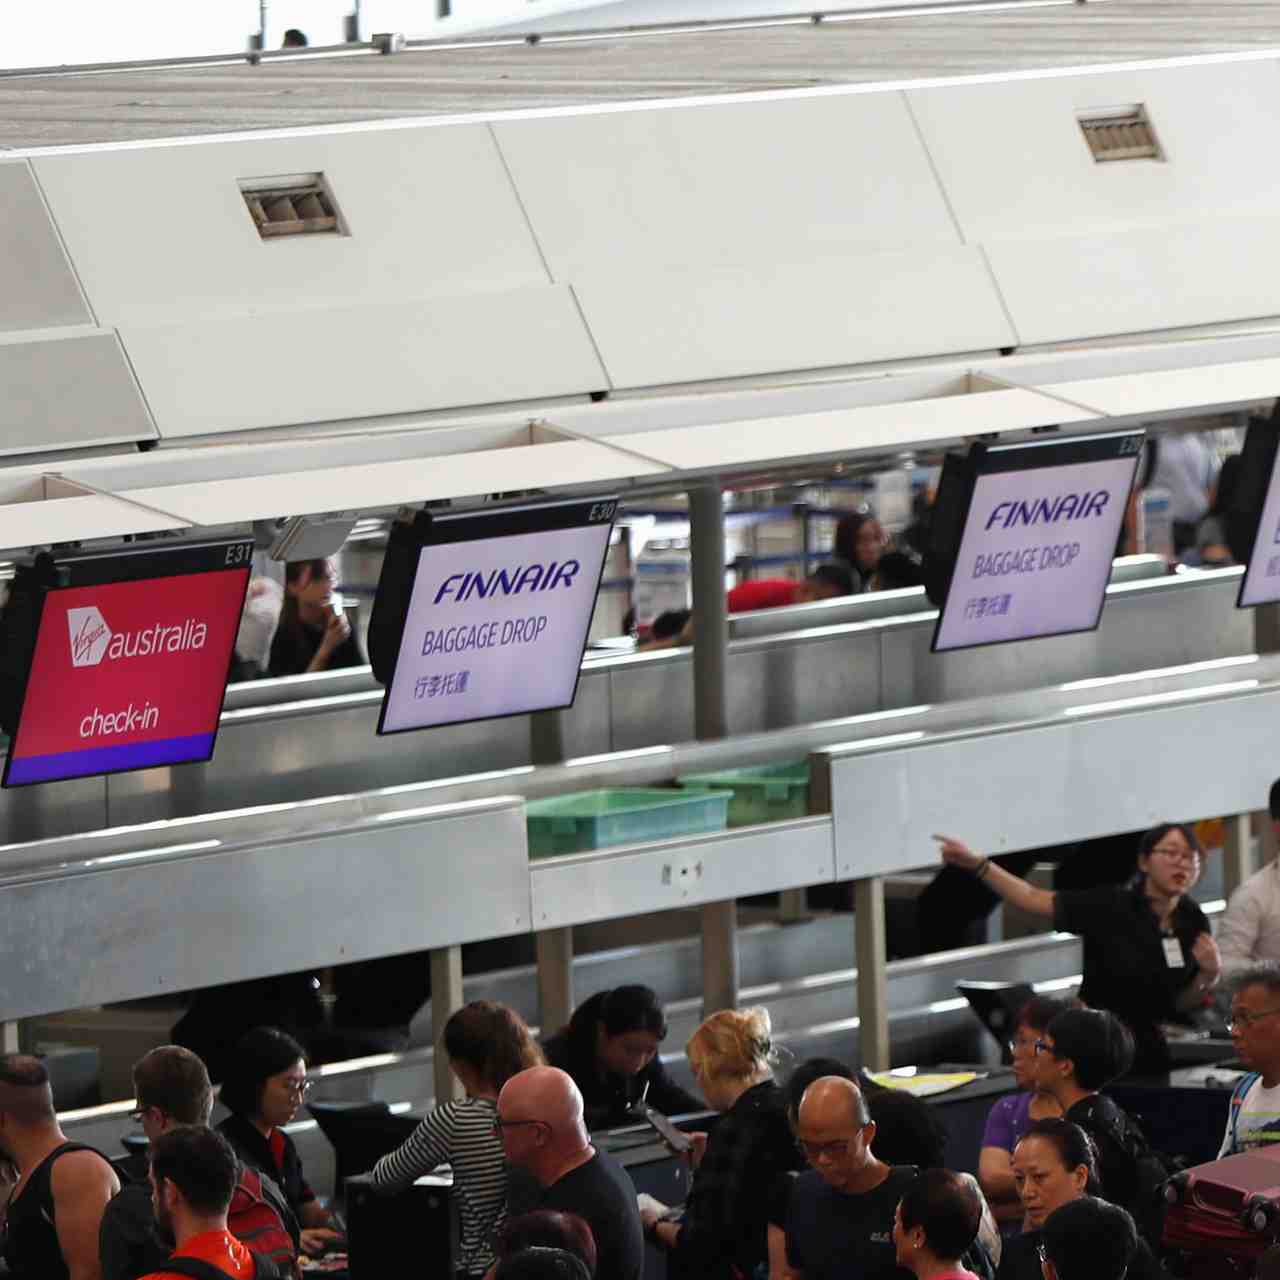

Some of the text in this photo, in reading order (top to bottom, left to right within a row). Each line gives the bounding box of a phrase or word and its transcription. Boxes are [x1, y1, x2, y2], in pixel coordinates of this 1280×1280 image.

[589, 503, 614, 521] E30
[985, 490, 1110, 531] FINNAIR
[225, 544, 250, 564] E31
[972, 542, 1080, 578] BAGGAGE DROP
[433, 559, 579, 604] FINNAIR
[108, 619, 207, 659] australia
[422, 615, 547, 656] BAGGAGE DROP
[79, 702, 159, 738] check-in
